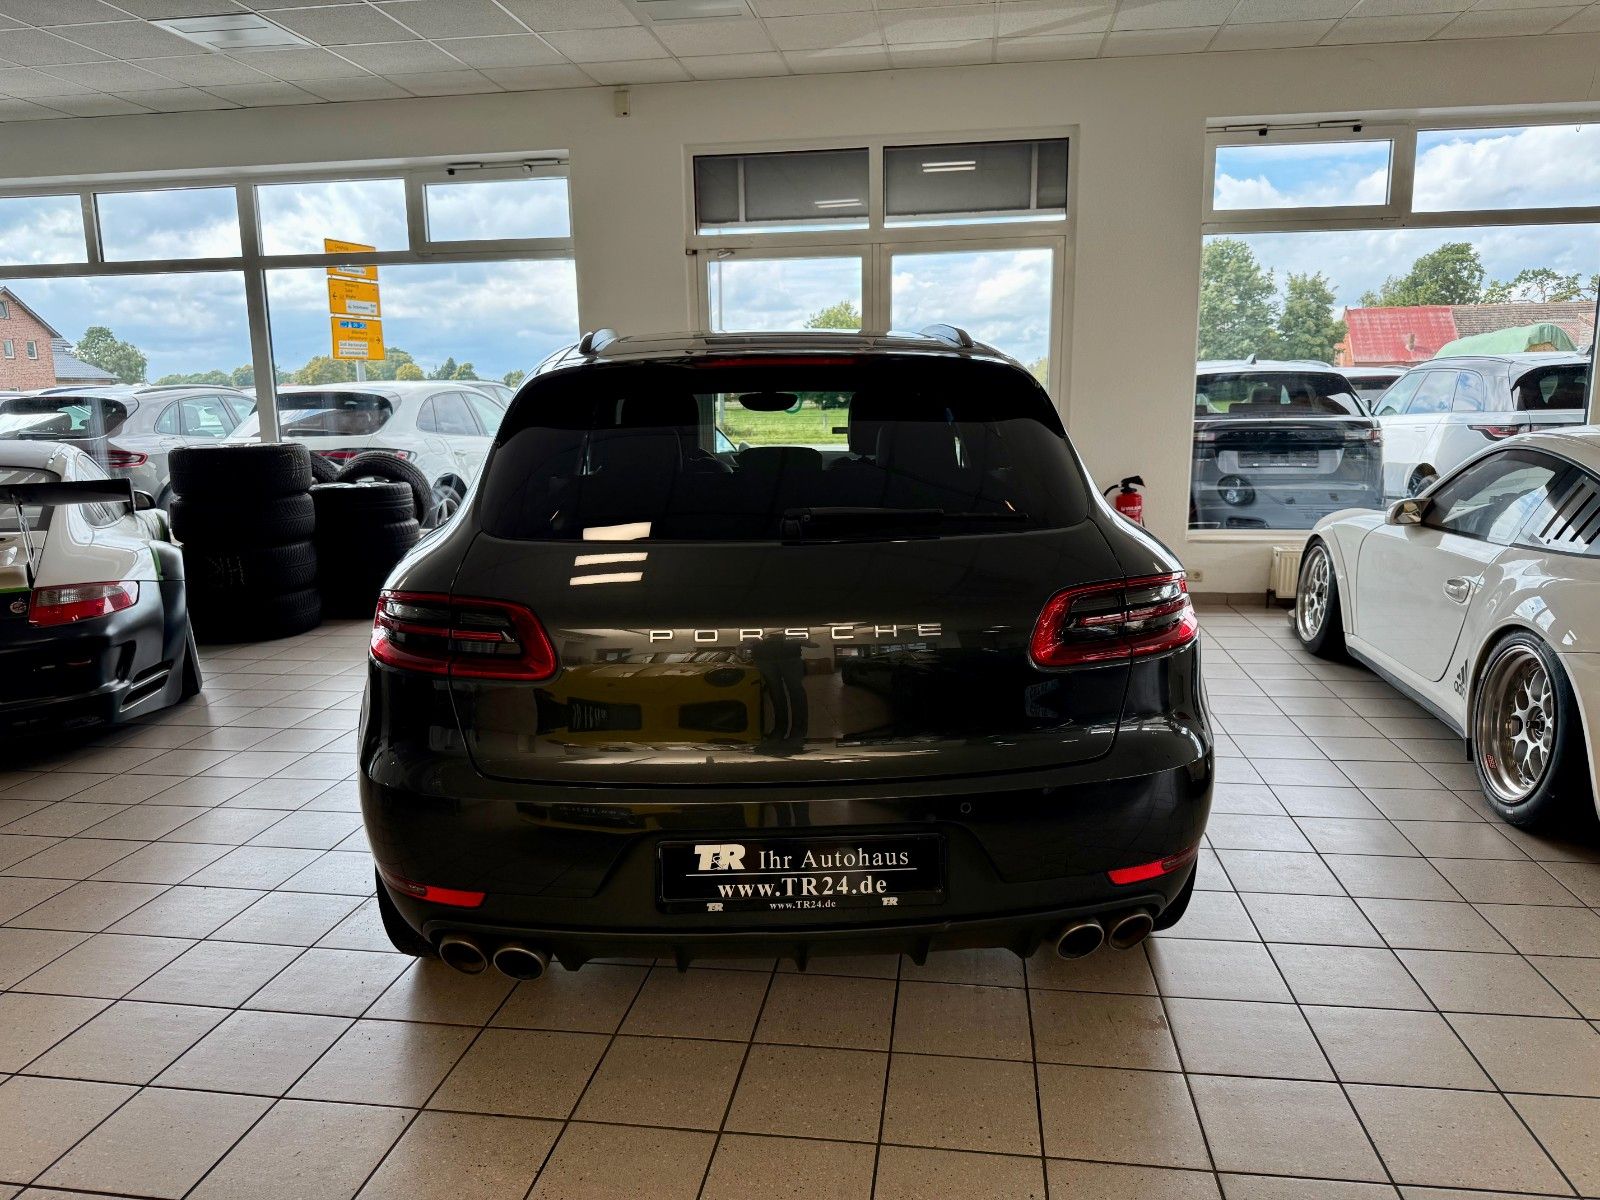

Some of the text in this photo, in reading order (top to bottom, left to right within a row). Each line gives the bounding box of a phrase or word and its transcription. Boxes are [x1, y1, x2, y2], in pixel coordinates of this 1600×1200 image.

[649, 622, 942, 643] PORSCHE
[759, 850, 793, 870] Ihr
[801, 847, 910, 869] Autohaus
[717, 875, 888, 898] www.TR24.de
[769, 899, 837, 910] www.TR24.de
